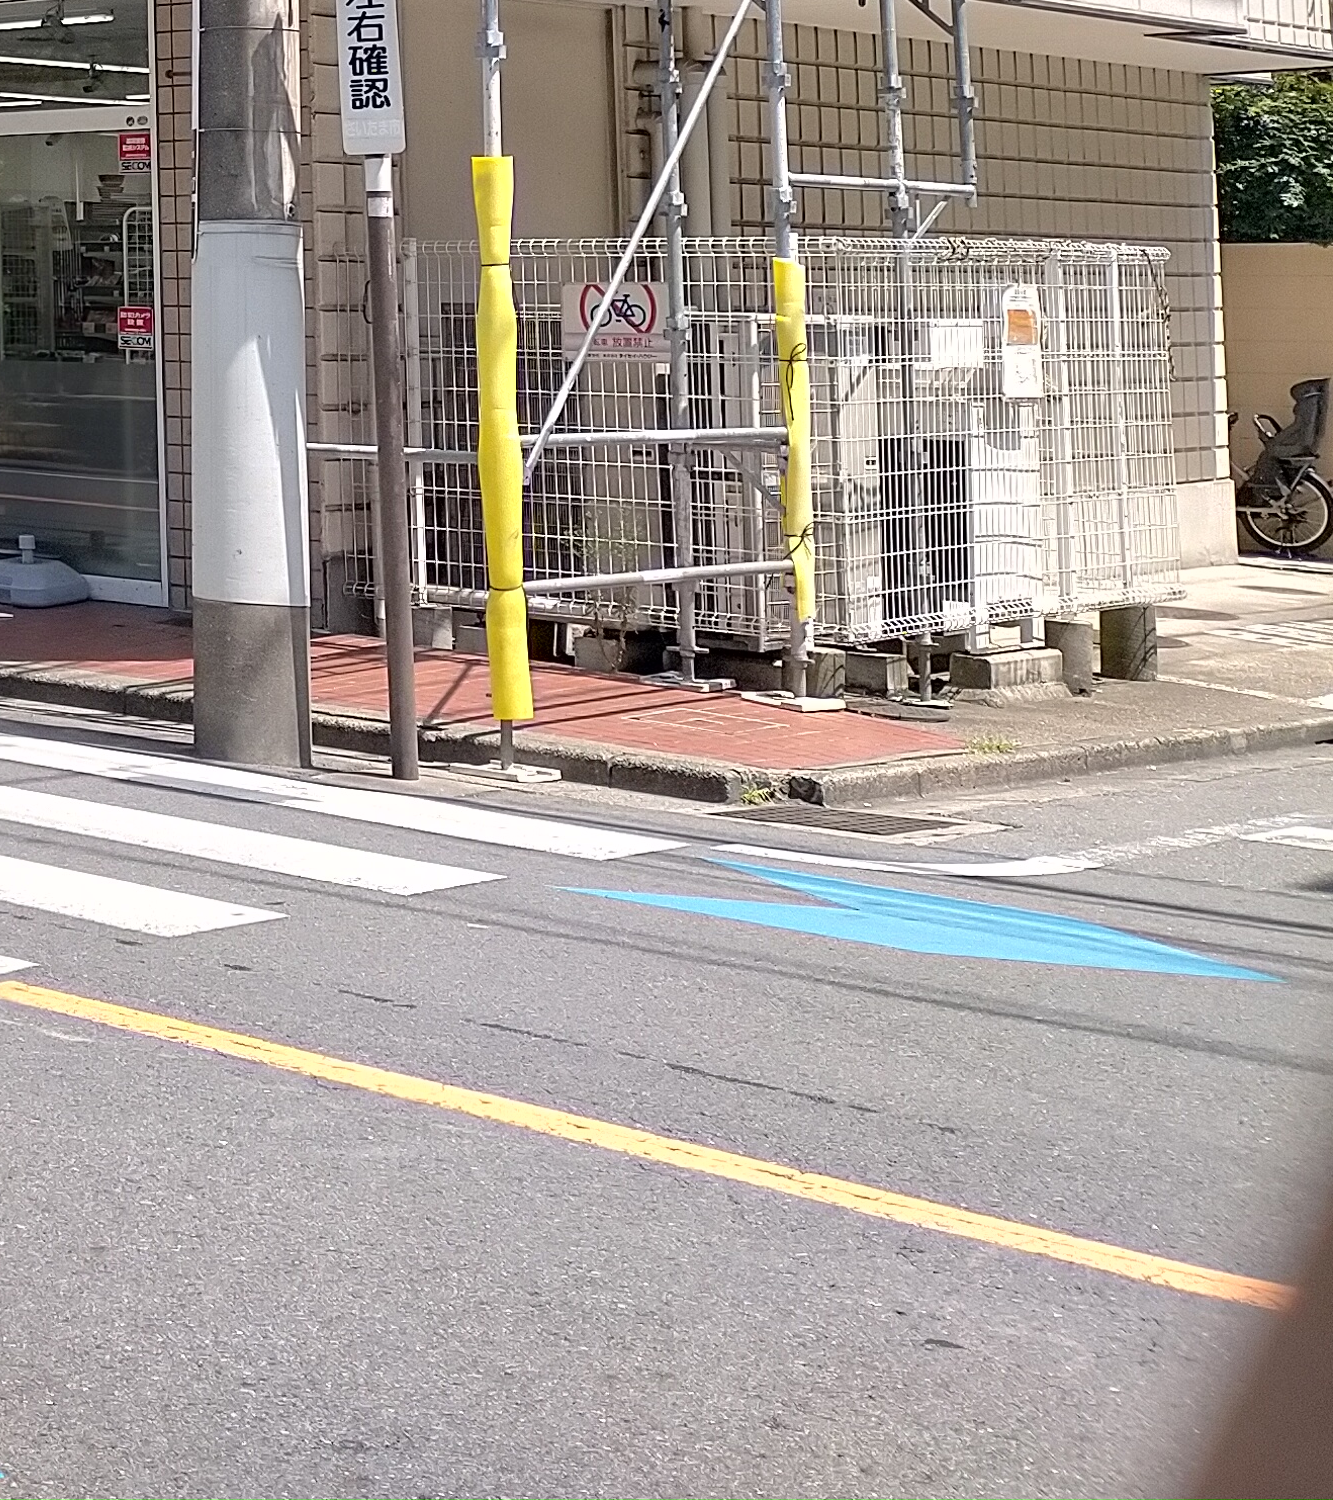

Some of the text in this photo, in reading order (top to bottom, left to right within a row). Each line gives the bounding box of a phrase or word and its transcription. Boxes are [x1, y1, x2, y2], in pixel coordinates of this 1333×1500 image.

[345, 119, 402, 138] さいたま市
[612, 337, 655, 349] 放置禁止
